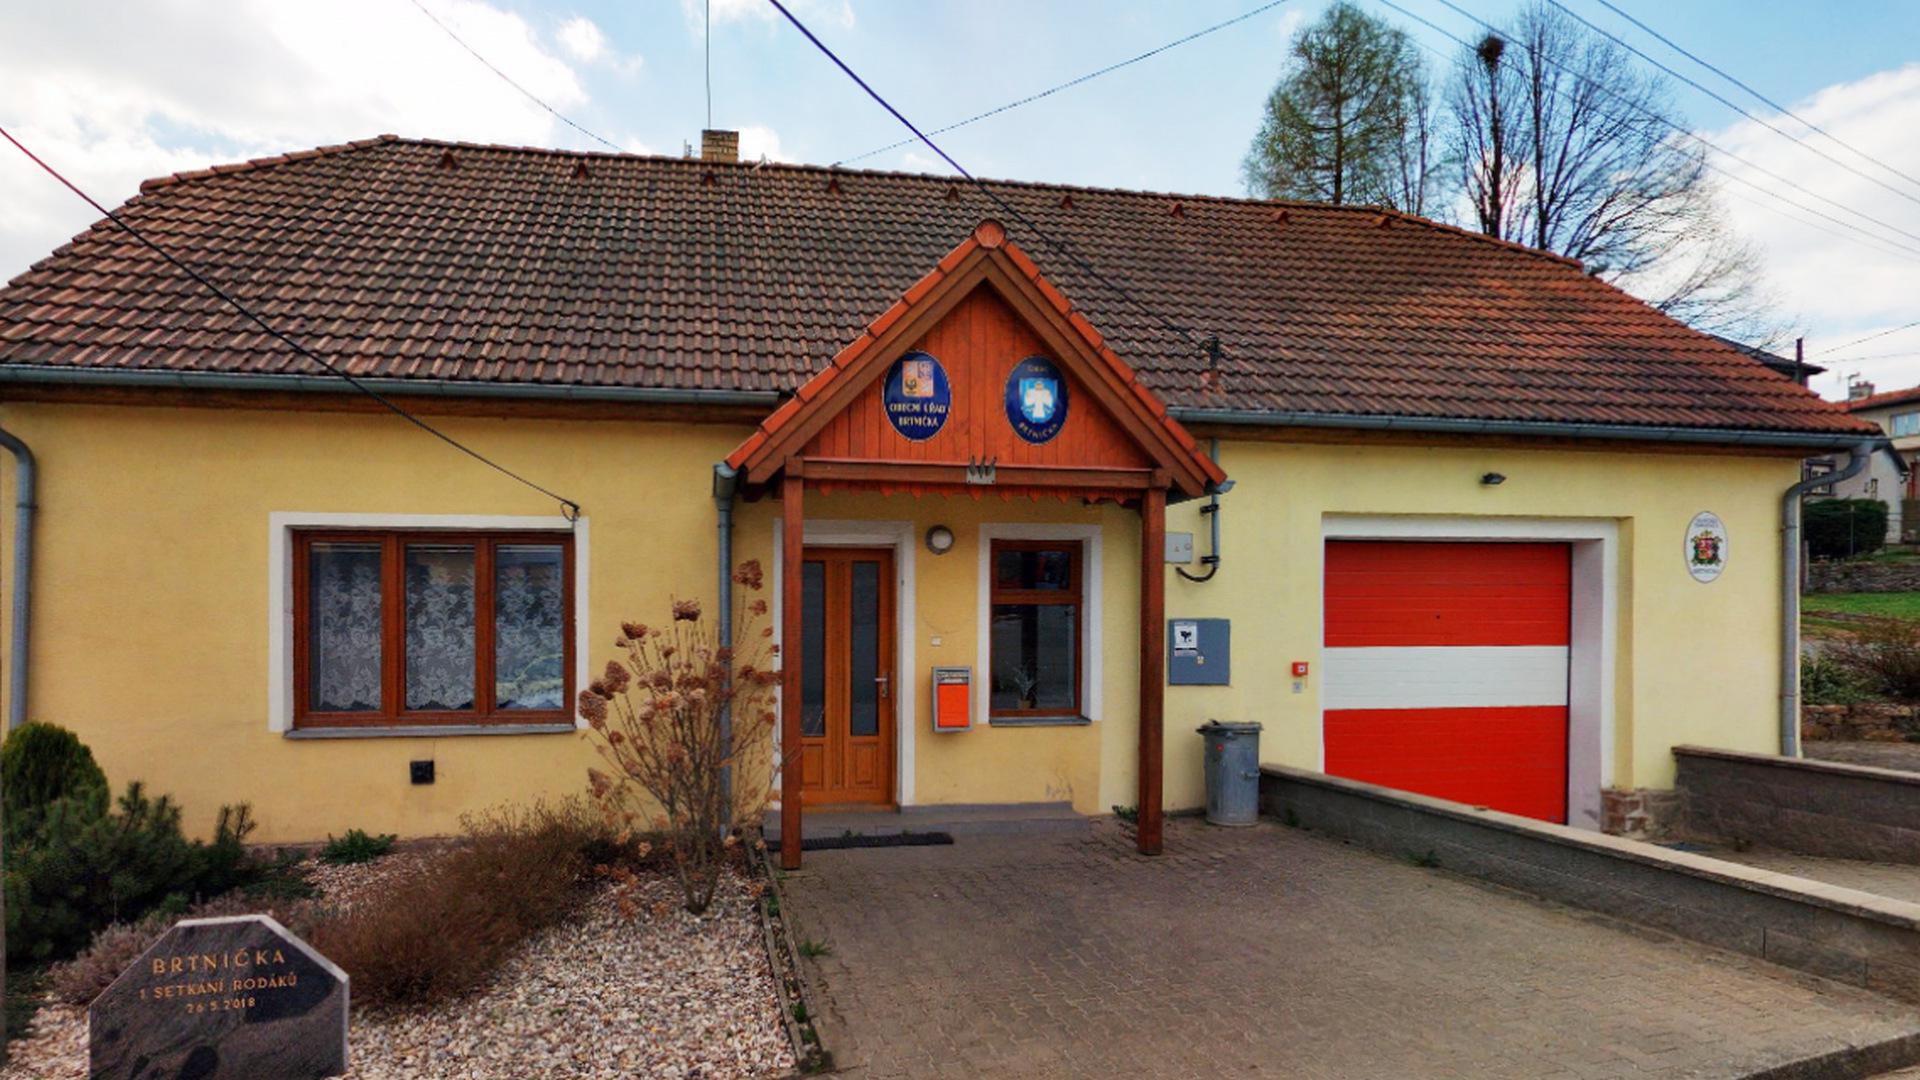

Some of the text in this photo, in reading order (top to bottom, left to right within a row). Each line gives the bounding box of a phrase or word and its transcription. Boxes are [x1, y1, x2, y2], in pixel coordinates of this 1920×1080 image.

[899, 415, 939, 427] BRTNIČKA
[152, 947, 286, 975] BRTNIČKA
[154, 978, 224, 999] SETKÁNÍ
[232, 971, 298, 992] RODÁKŮ
